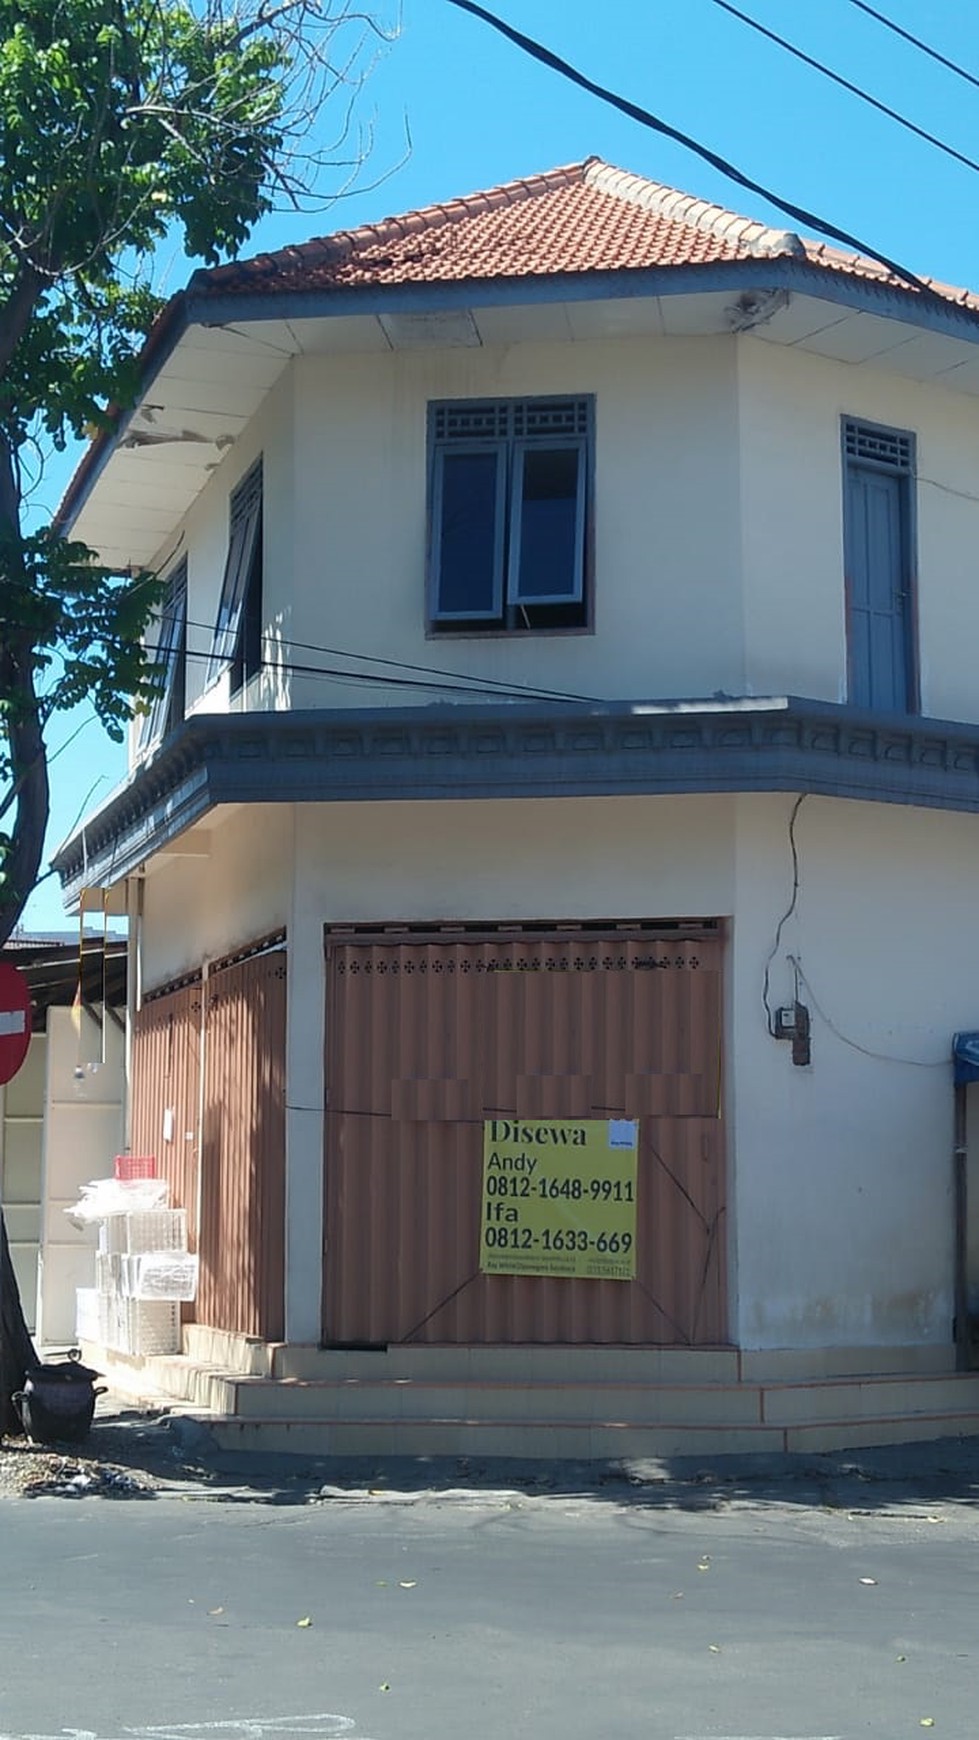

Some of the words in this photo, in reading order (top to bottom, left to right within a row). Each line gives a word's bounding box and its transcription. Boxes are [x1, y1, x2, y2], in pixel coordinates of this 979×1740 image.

[490, 1120, 587, 1146] Disewa
[487, 1152, 537, 1175] Andy
[486, 1175, 634, 1202] 0812-1648-9911
[486, 1202, 518, 1222] Ifa
[485, 1227, 632, 1254] 0812-1633-669
